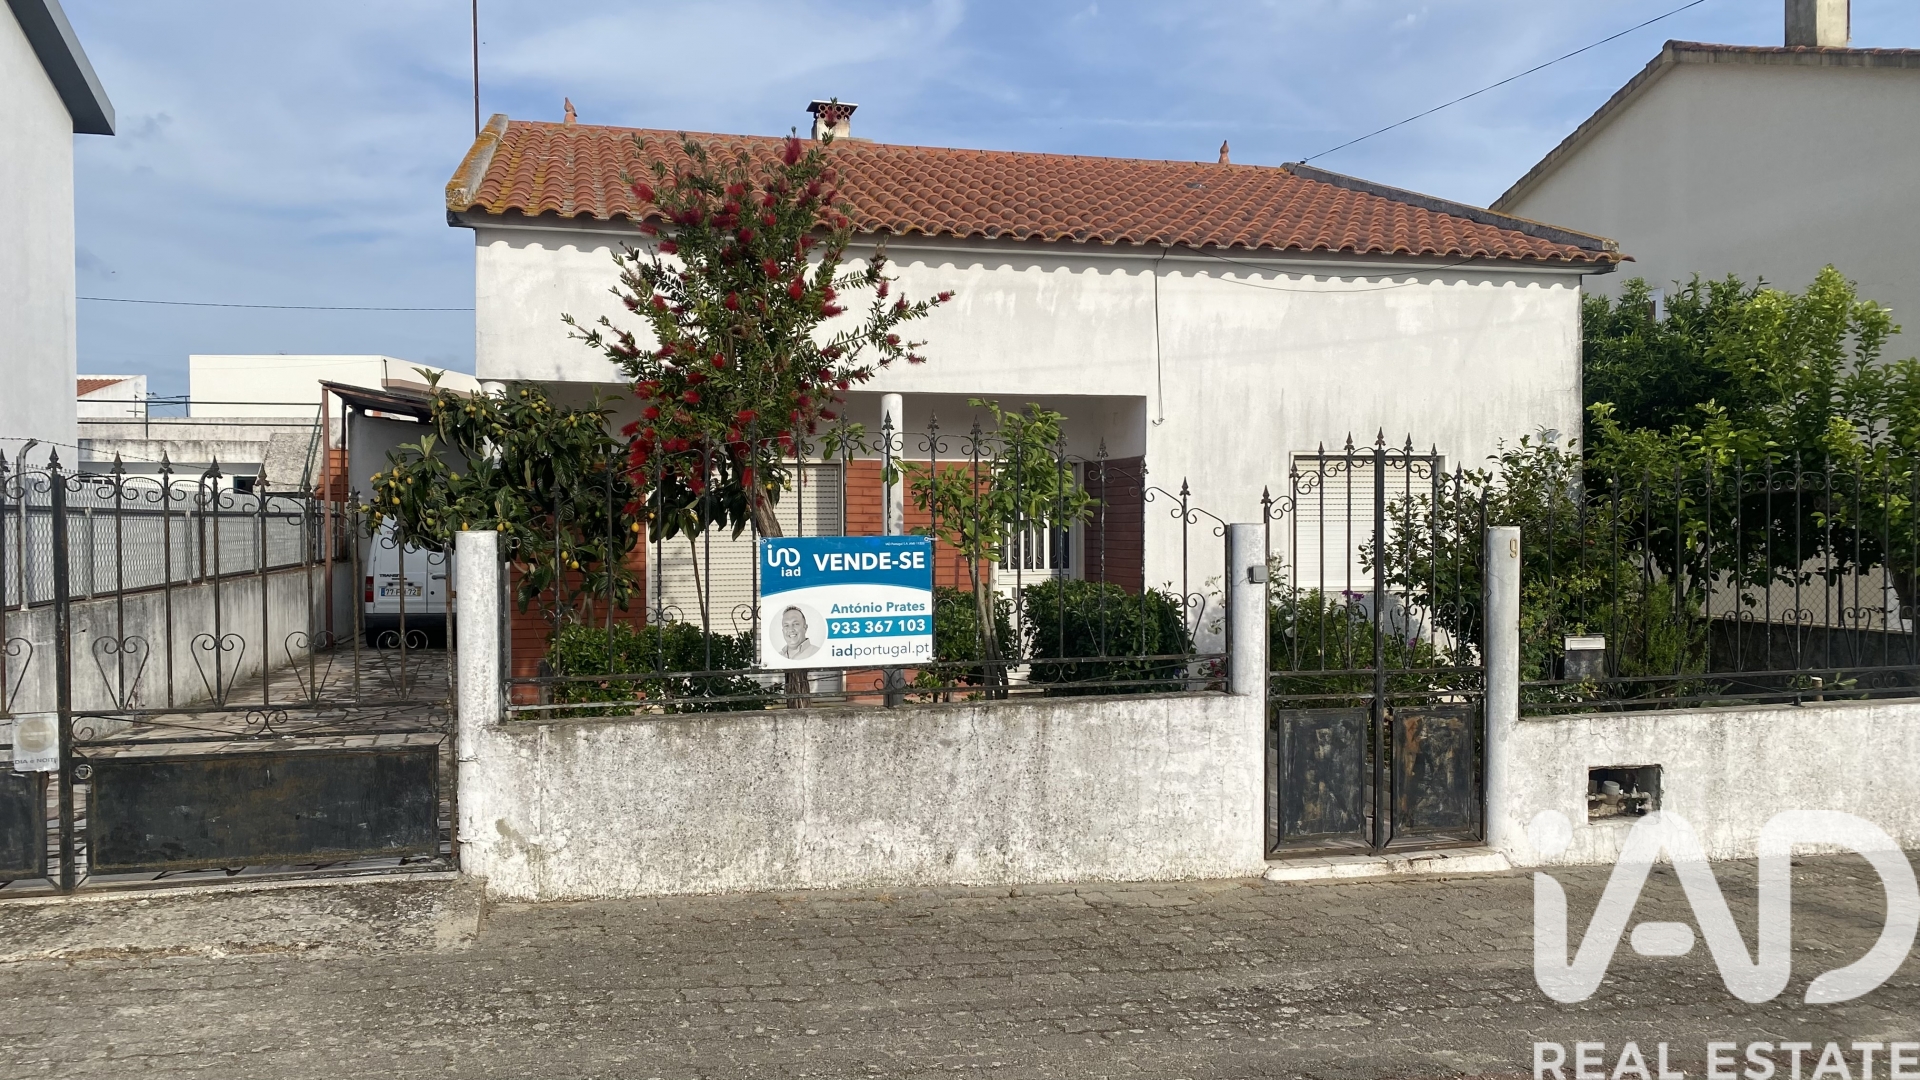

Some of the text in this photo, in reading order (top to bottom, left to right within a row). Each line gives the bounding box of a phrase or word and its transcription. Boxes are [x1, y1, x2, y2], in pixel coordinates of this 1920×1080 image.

[1509, 538, 1518, 559] 9
[812, 551, 925, 571] VENDE-SE
[781, 566, 801, 577] iad
[830, 601, 925, 614] António Prates
[831, 618, 926, 635] 933 367 103
[831, 641, 930, 658] iadportugal.pt
